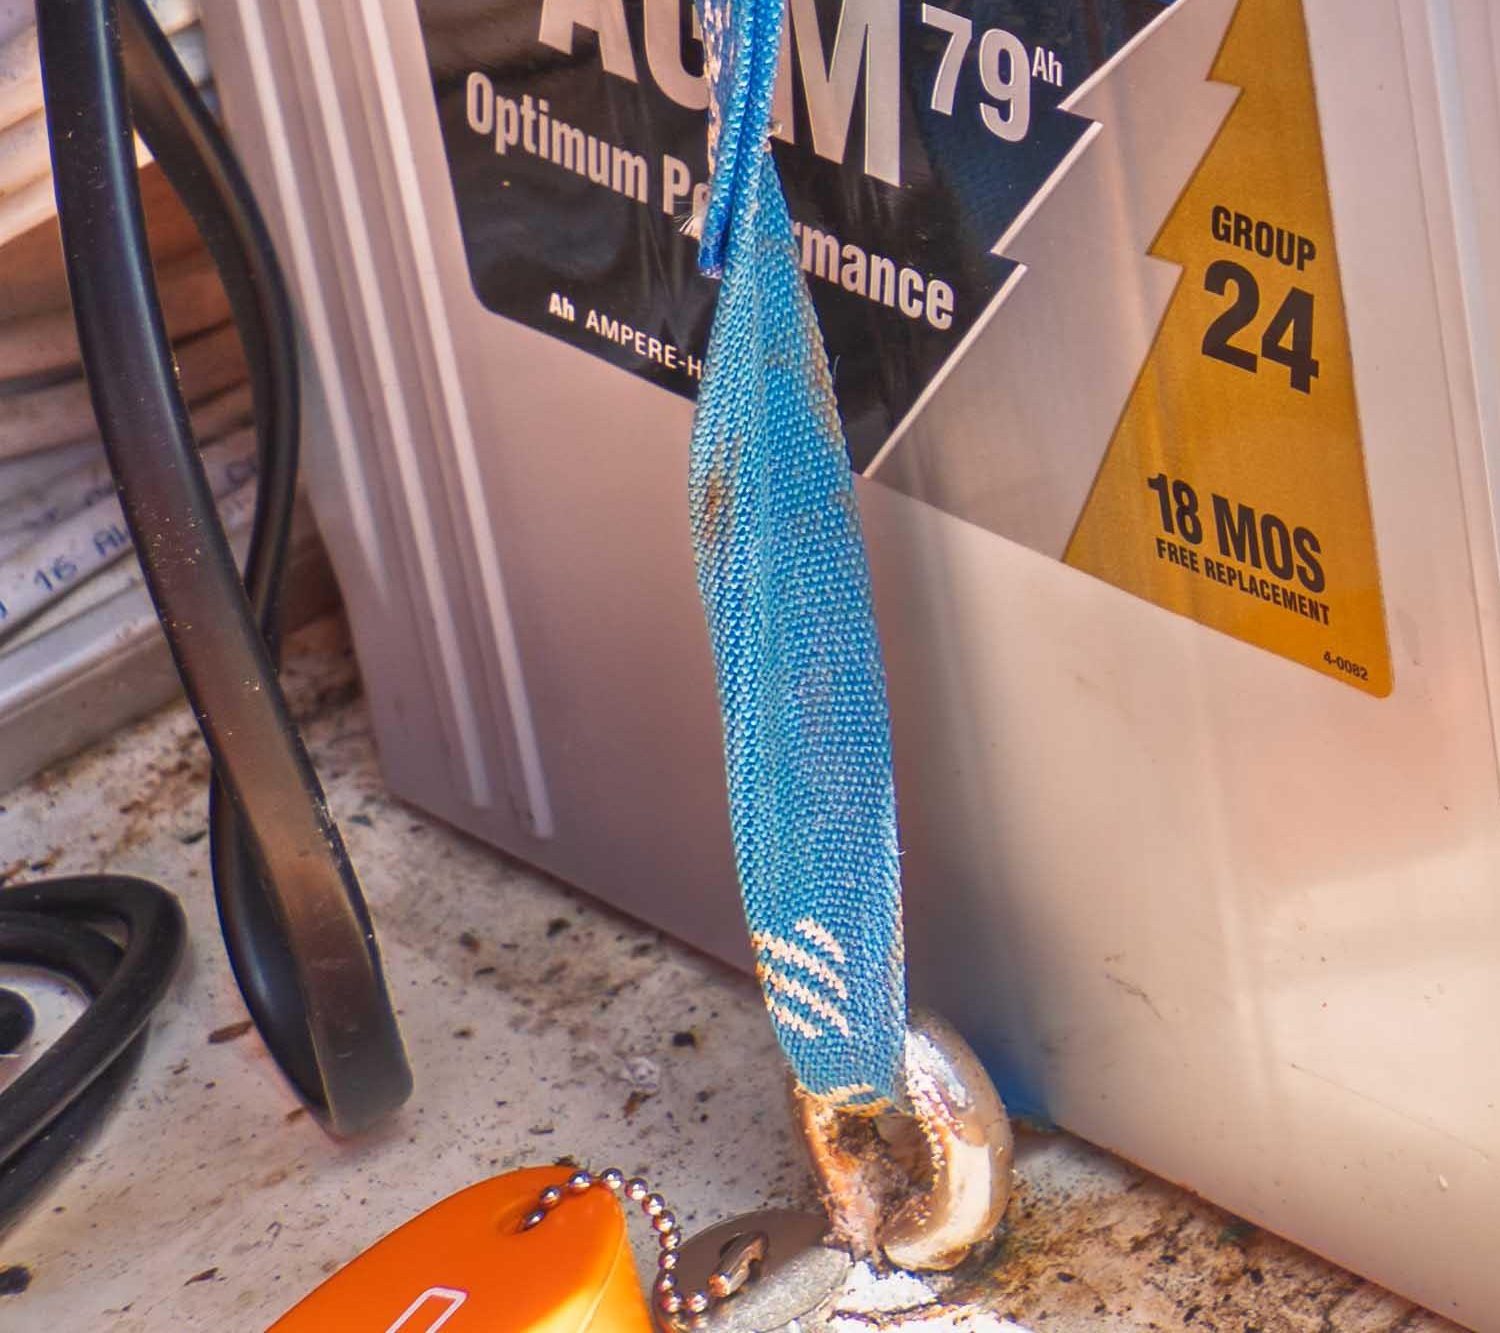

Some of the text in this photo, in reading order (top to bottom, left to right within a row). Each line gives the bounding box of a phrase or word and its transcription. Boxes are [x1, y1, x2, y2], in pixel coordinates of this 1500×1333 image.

[465, 69, 649, 206] Optimum
[1210, 204, 1317, 272] GROUP
[548, 290, 701, 383] Ah AMPERE-H
[1201, 258, 1321, 396] 24
[1147, 472, 1327, 596] 18 MOS
[1154, 536, 1331, 627] FREE REPLACEMENT
[1322, 649, 1370, 683] 4-0082
